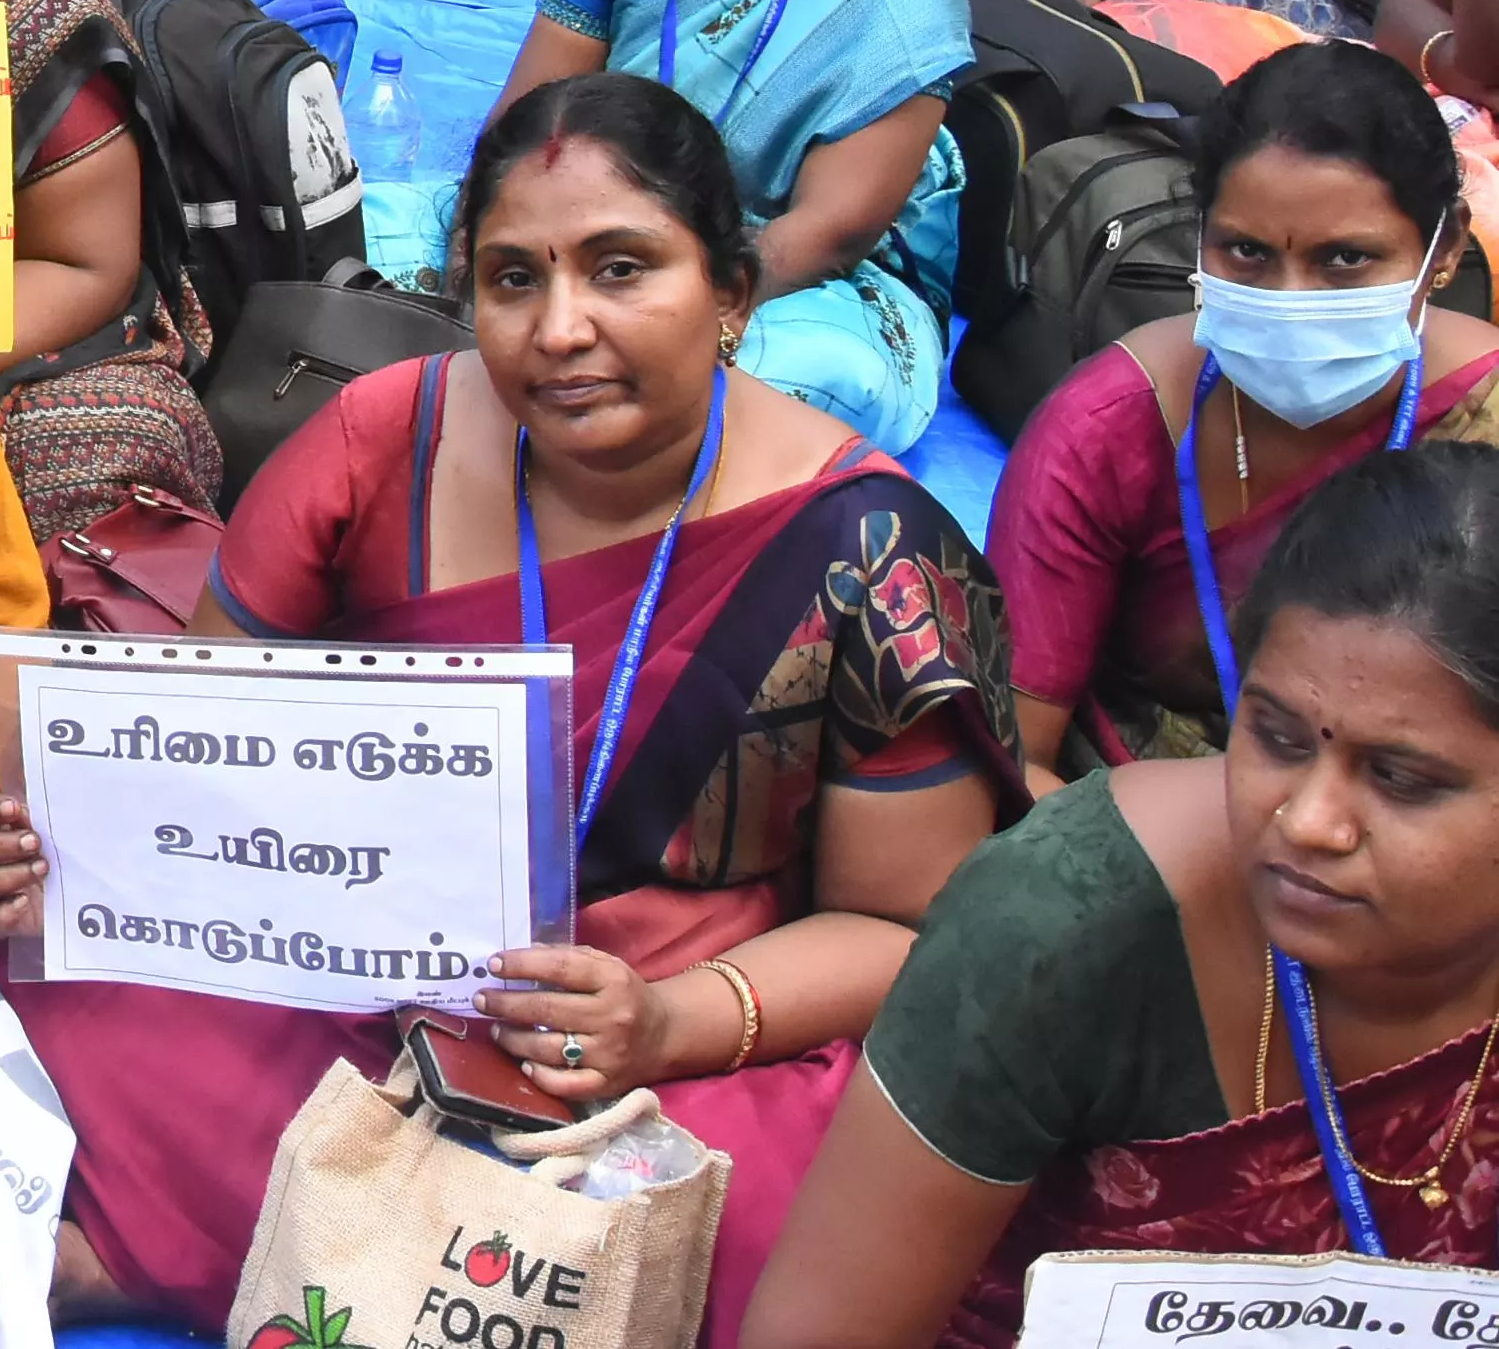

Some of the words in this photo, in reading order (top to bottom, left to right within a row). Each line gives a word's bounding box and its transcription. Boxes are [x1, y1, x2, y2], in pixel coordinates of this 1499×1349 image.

[47, 714, 276, 768] உரிமை
[293, 722, 494, 782] எடுக்க
[154, 823, 391, 890] உயிரை
[77, 902, 490, 981] கொடுப்போம்.
[1145, 1290, 1406, 1345] தேவை..
